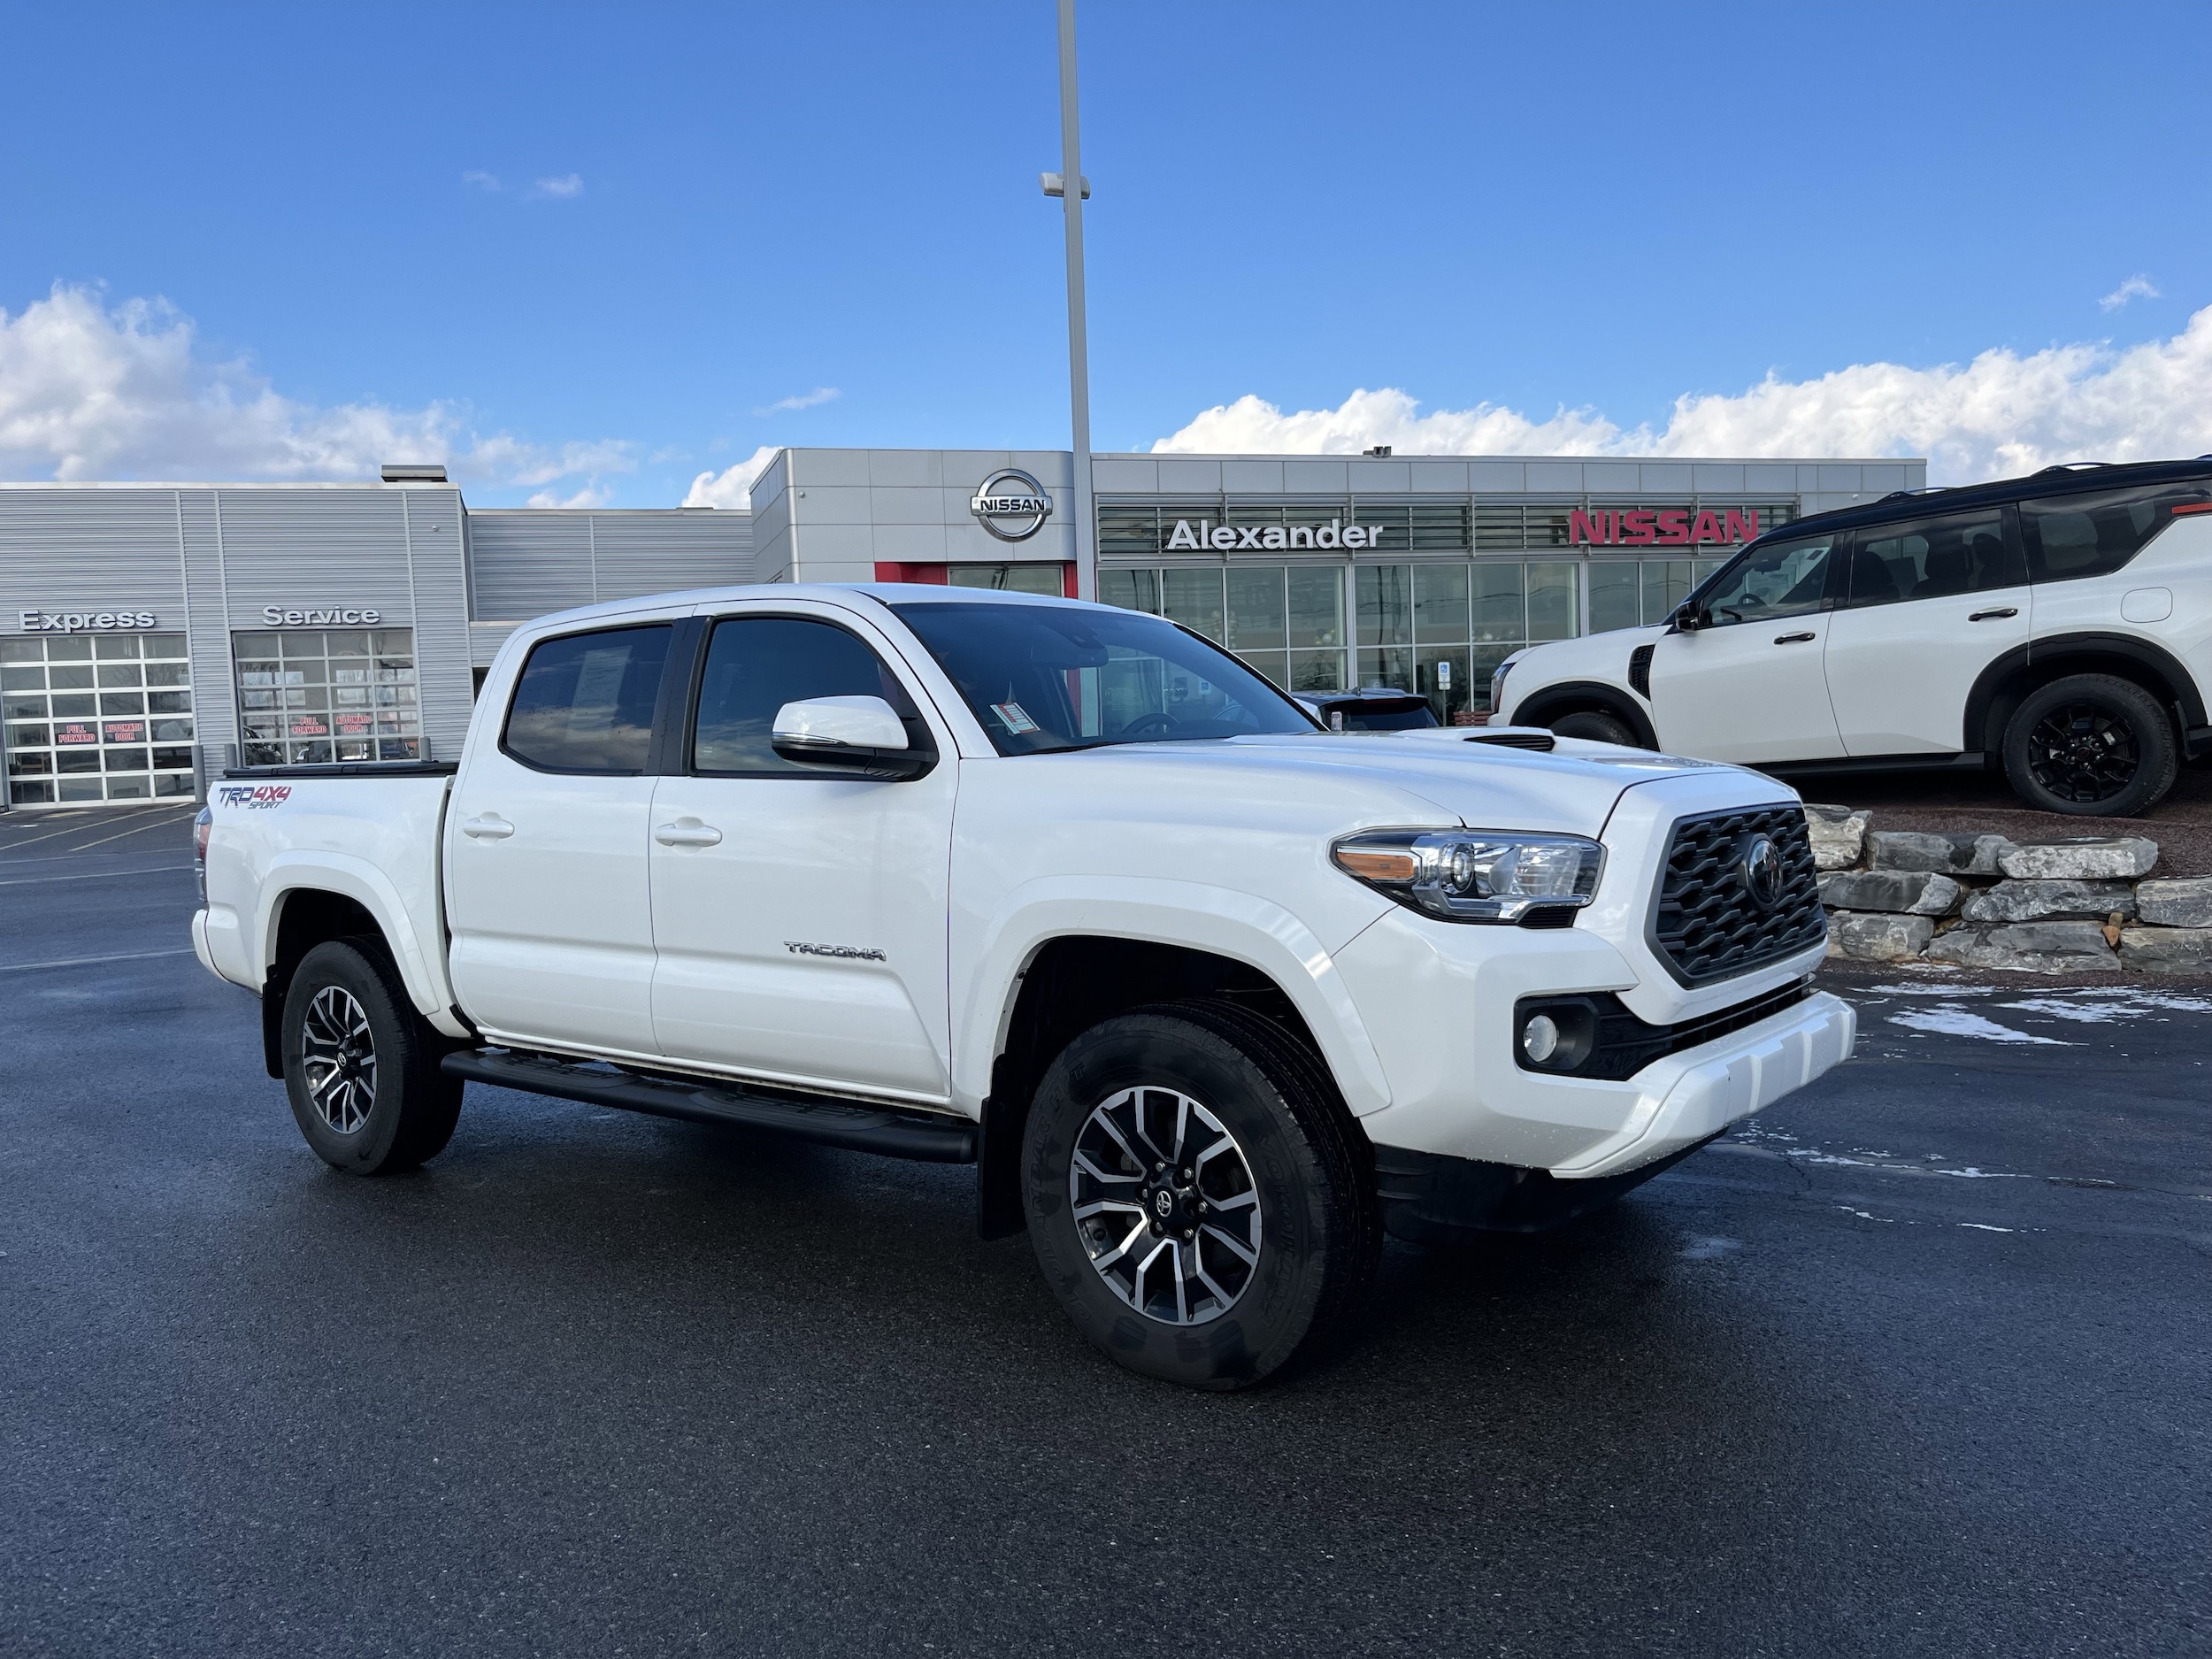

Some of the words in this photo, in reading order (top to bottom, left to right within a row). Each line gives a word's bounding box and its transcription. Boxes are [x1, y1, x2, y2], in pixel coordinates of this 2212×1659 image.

[980, 499, 1045, 511] NISSAN
[1570, 510, 1759, 544] NISSAN
[1166, 518, 1384, 550] Alexander
[262, 605, 380, 626] Service
[18, 610, 156, 634] Express
[299, 716, 319, 726] PULL
[335, 715, 373, 725] AUTOMATIC
[66, 725, 87, 733] PULL
[105, 723, 144, 733] AUTOMATIC
[291, 726, 327, 734] FORWARD
[343, 724, 364, 733] DOOR
[58, 733, 96, 742] FORWARD
[114, 732, 135, 741] DOOR
[248, 801, 284, 810] SPORT
[783, 941, 887, 962] TACOMA
